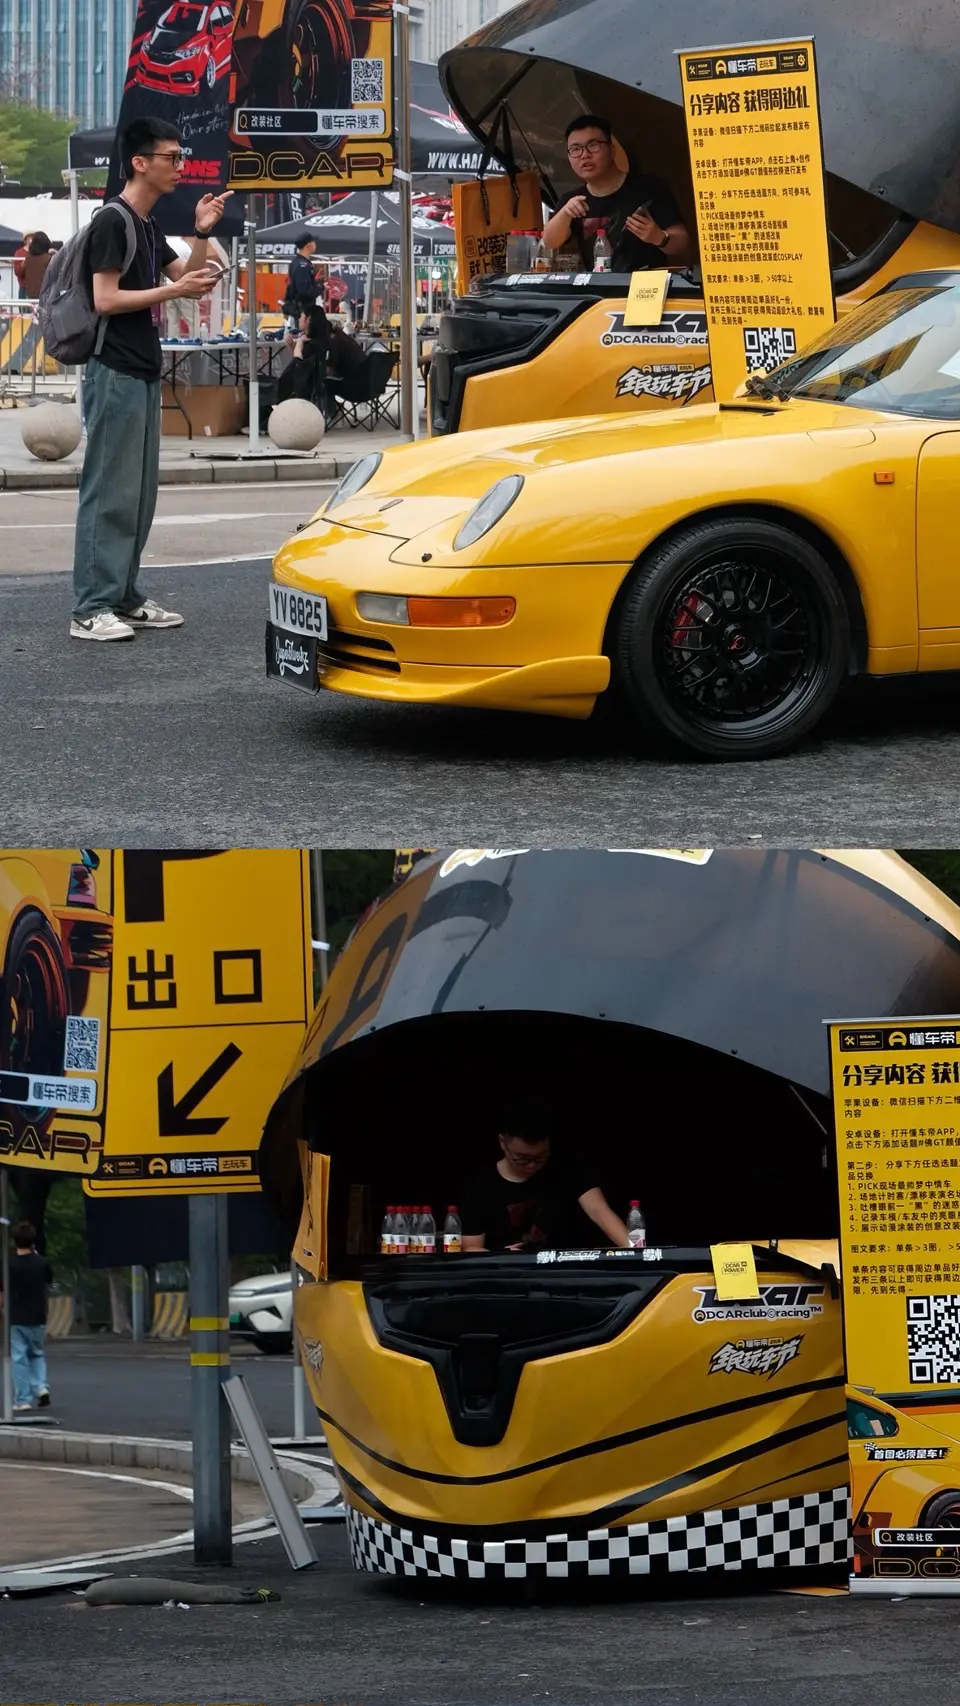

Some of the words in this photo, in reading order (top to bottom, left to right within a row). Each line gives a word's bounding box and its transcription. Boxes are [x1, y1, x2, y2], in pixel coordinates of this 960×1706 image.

[690, 92, 740, 116] 分享内容
[744, 86, 810, 112] 获得周边礼
[251, 115, 282, 128] 改装社区
[321, 114, 381, 130] 懂车帝搜索
[229, 152, 385, 180] DCAR
[127, 949, 262, 1010] 出口
[909, 1032, 955, 1046] 懂车帝
[842, 1063, 926, 1086] 分享内容
[33, 1081, 91, 1103] 懂车帝搜索
[845, 1109, 862, 1118] 内容
[170, 1156, 217, 1174] 懂车帝
[710, 1339, 801, 1376] 全民玩车节
[896, 1533, 933, 1541] 改装社区
